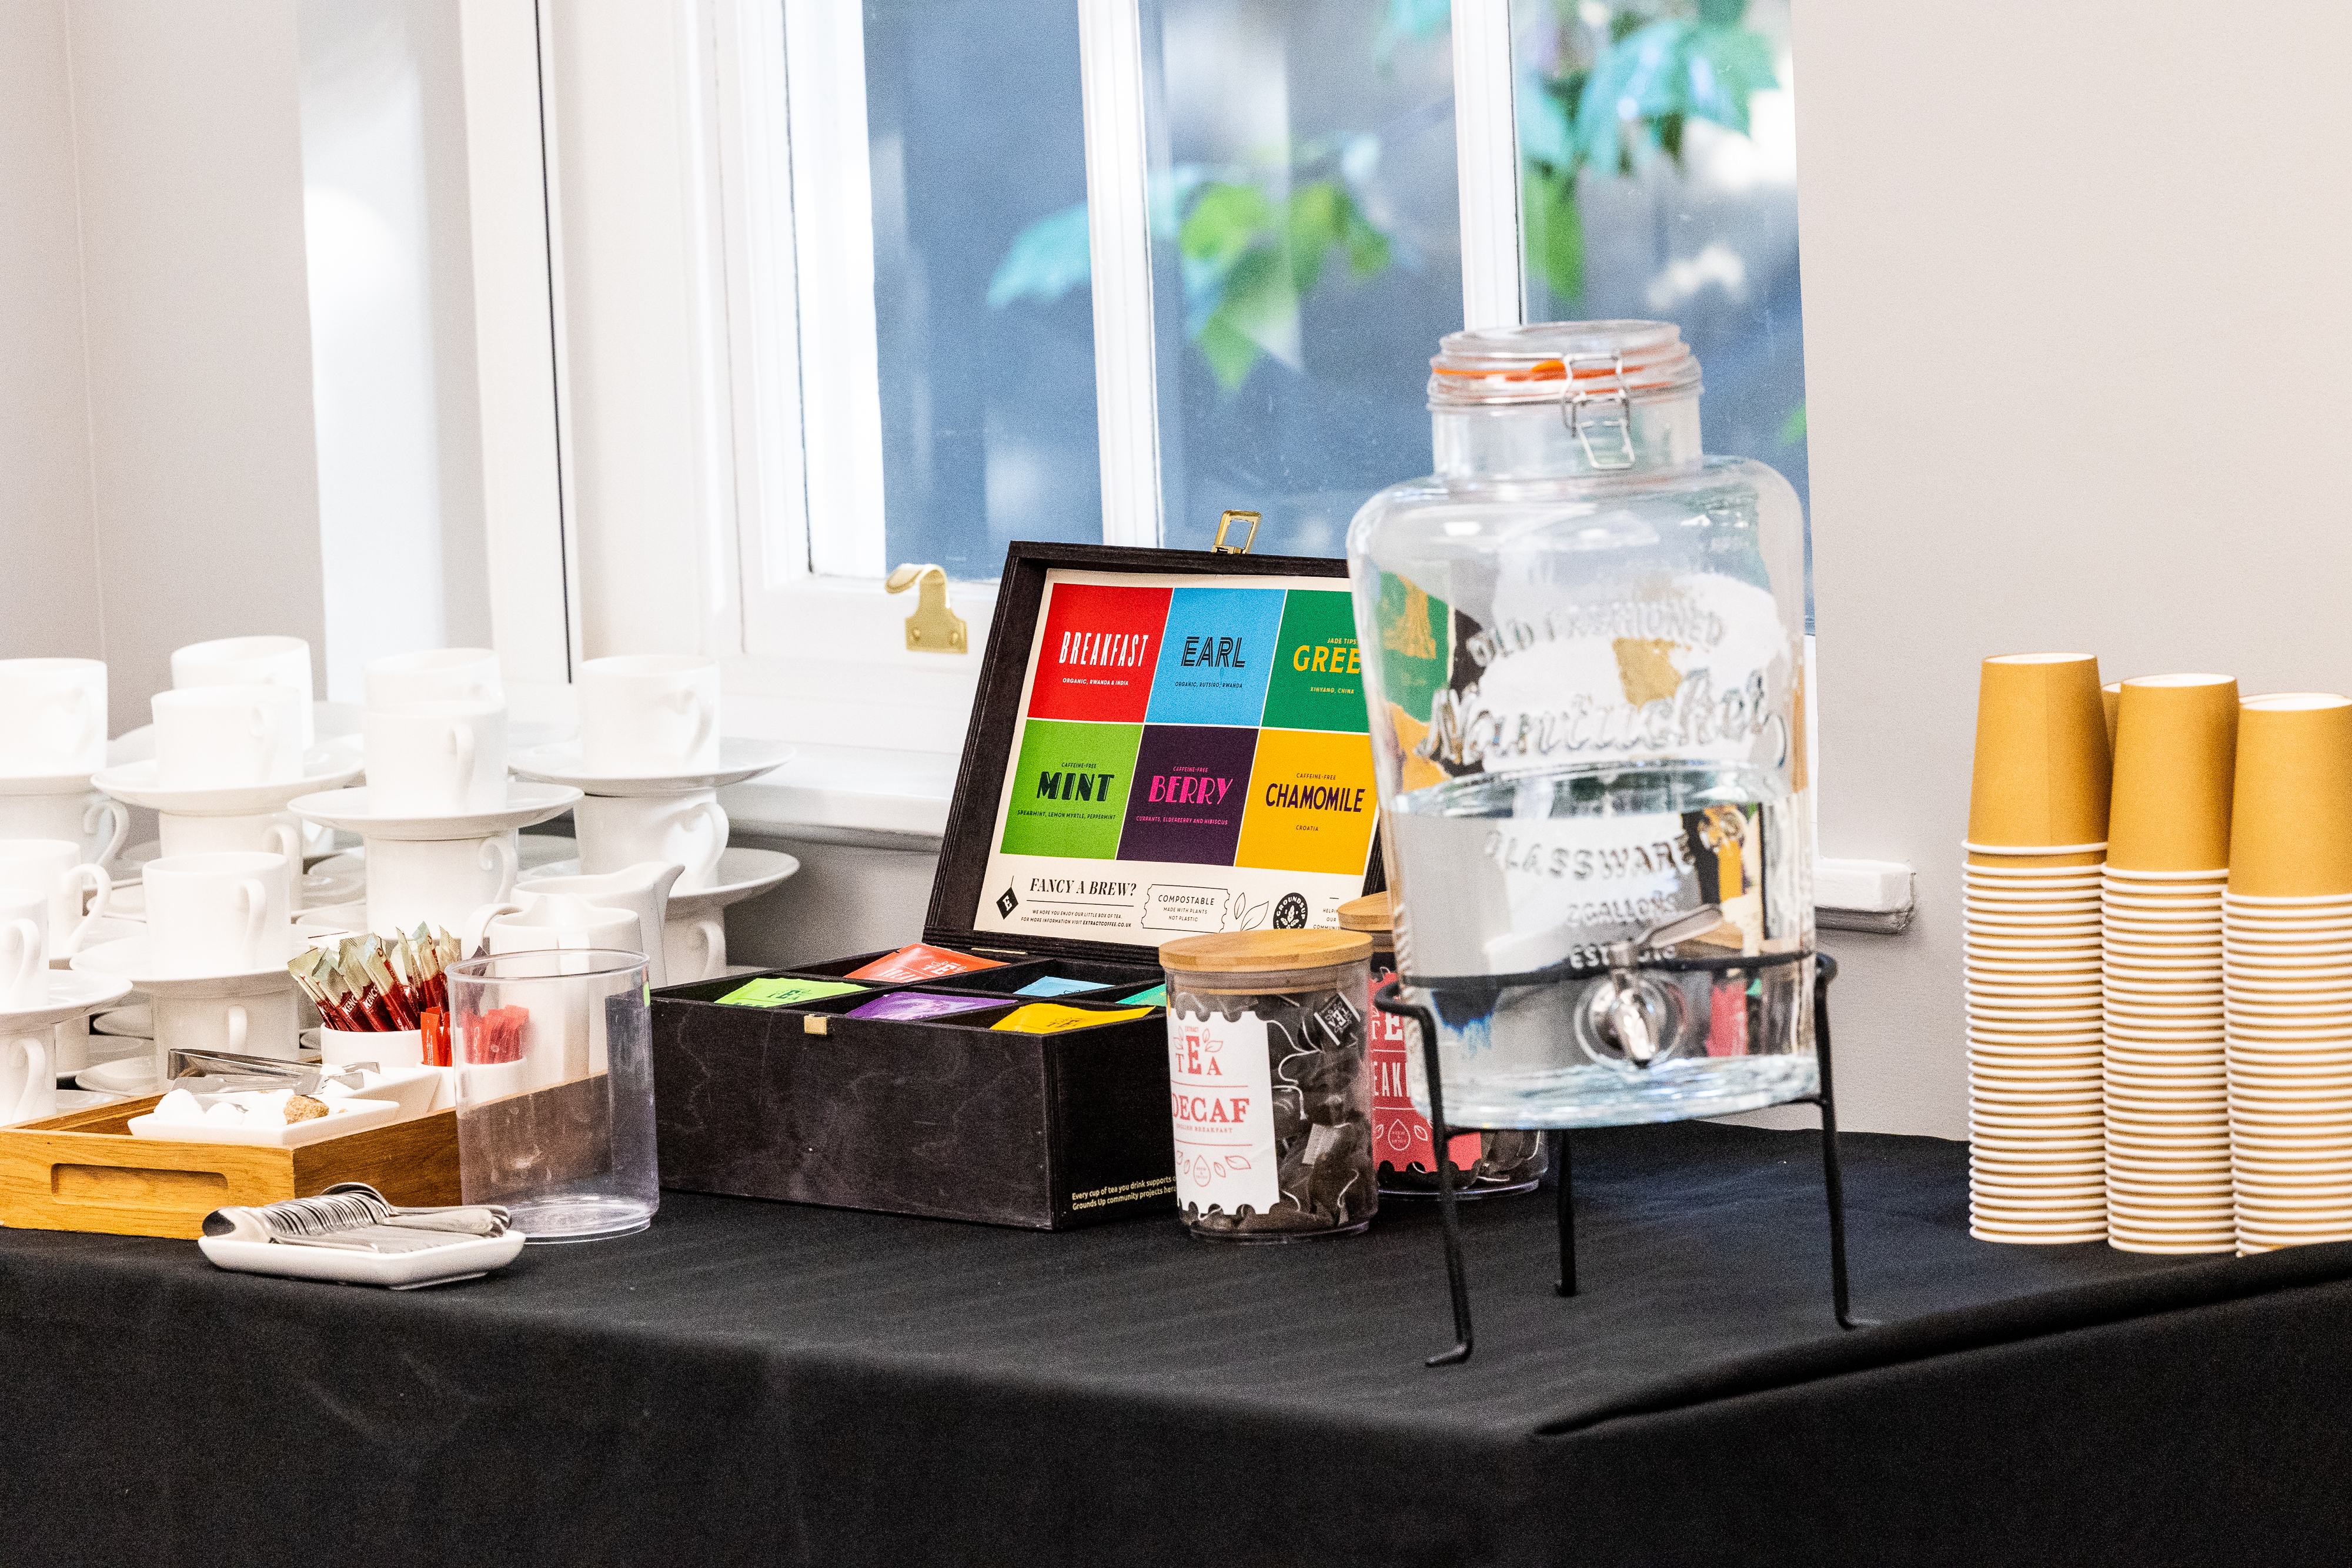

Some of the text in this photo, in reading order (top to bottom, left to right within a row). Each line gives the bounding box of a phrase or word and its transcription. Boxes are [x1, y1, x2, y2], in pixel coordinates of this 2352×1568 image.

[1058, 631, 1149, 667] BREAKFAST
[1181, 636, 1246, 668] EARL
[1293, 645, 1361, 674] GREE
[1036, 771, 1115, 801] MINT
[1148, 775, 1233, 805] BERRY
[1265, 783, 1366, 813] CHAMOMILE
[1030, 878, 1137, 897] FANCY A BREW?
[1158, 894, 1215, 905] COMPOSTABLE
[1002, 895, 1013, 911] E
[341, 994, 358, 1016] KENC
[1372, 1011, 1404, 1041] TE
[1175, 1035, 1223, 1076] TEA
[1171, 1092, 1250, 1123] DECAF
[1072, 1192, 1088, 1201] Every
[1101, 1186, 1108, 1195] of
[1118, 1185, 1130, 1193] you
[1130, 1180, 1146, 1189] drink
[1147, 1176, 1172, 1186] supports
[1073, 1199, 1097, 1211] Grounds
[1097, 1198, 1106, 1206] Up
[1107, 1192, 1139, 1204] community
[1140, 1188, 1163, 1200] projects
